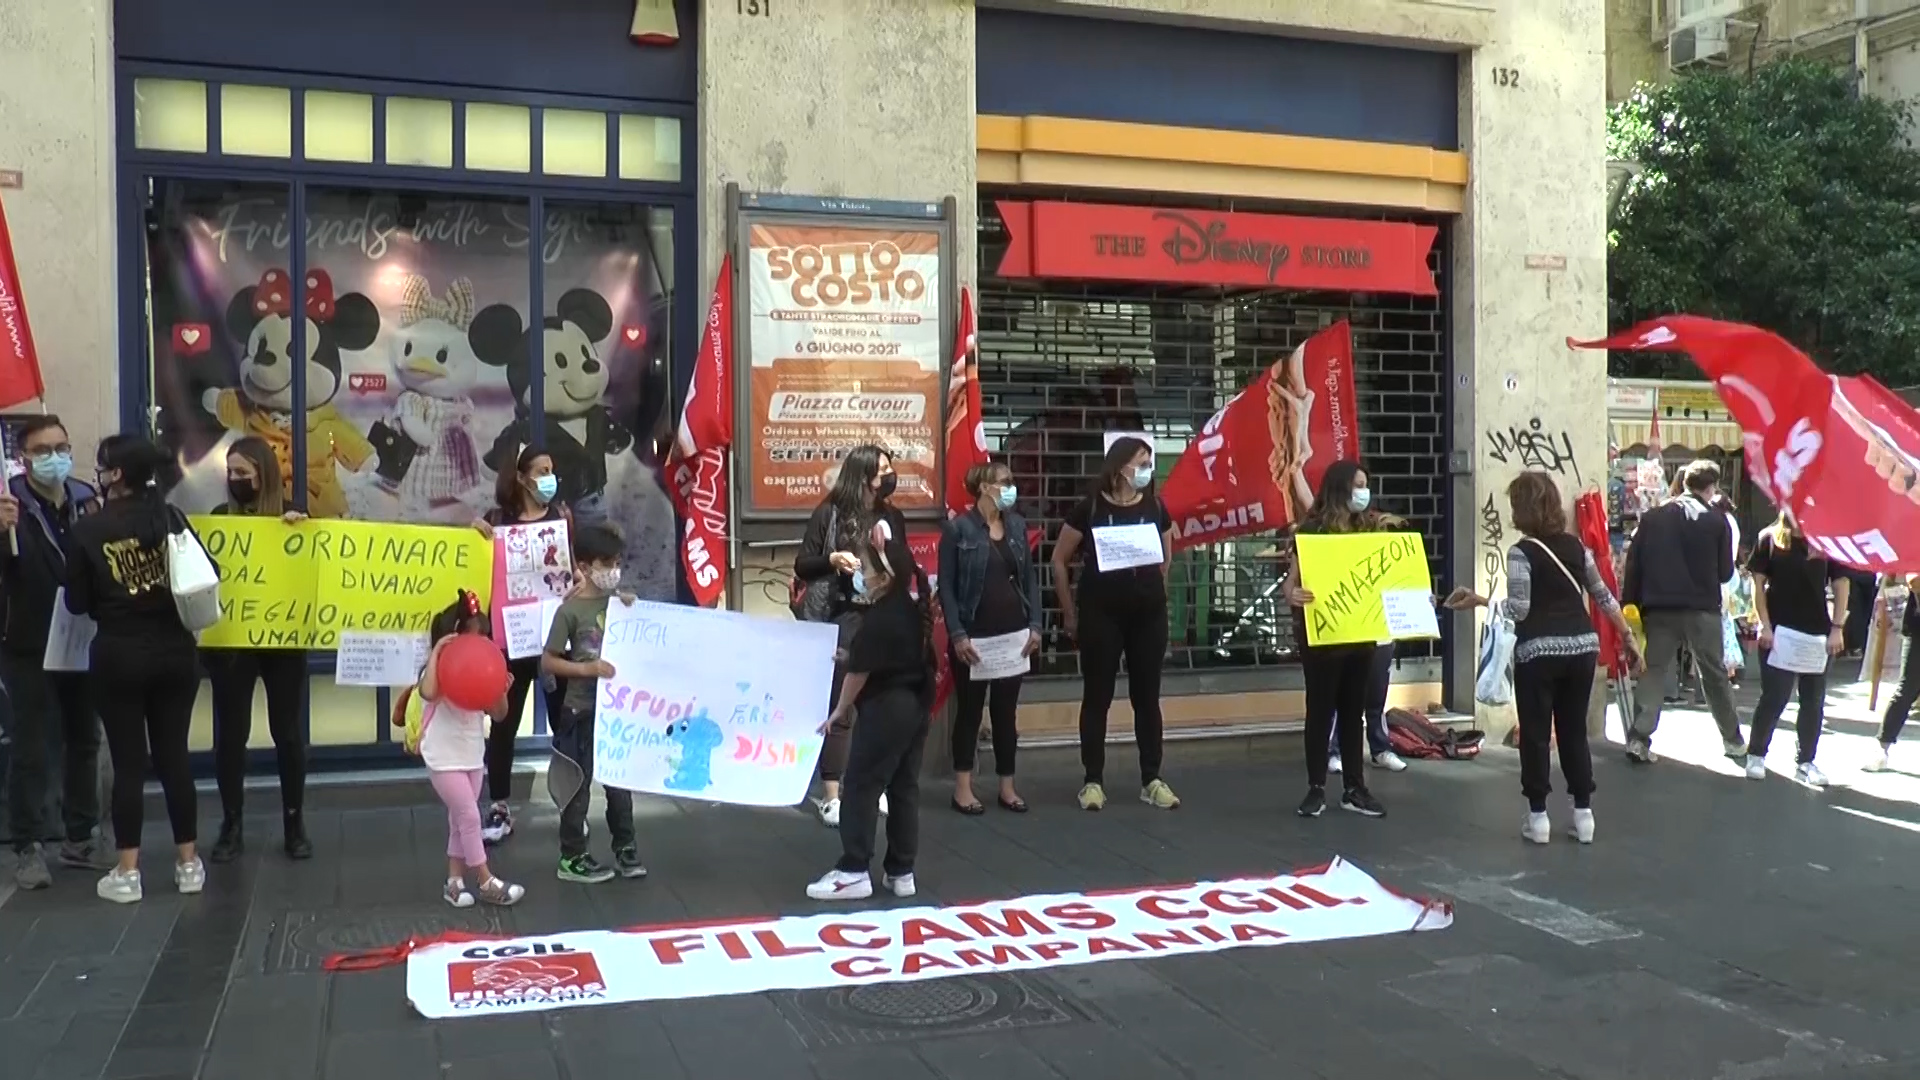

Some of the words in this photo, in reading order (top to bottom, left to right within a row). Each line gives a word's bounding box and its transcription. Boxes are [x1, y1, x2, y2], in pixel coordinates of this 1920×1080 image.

[1491, 66, 1520, 88] 132
[767, 241, 901, 281] SOTTO
[1092, 233, 1146, 258] THE
[1302, 245, 1373, 270] STORE
[791, 270, 925, 307] COSTO
[794, 341, 803, 353] 6
[807, 342, 865, 354] GIUGNO
[782, 393, 843, 409] Piazza
[847, 394, 914, 411] Cavour
[763, 474, 821, 486] expert
[786, 485, 821, 495] NAPOLI
[197, 529, 253, 557] ON
[284, 529, 470, 569] ORDINARE
[341, 568, 433, 595] DIVANO
[1313, 534, 1416, 640] AMMAZZON
[341, 612, 355, 627] IL
[361, 610, 432, 630] CONTA
[248, 629, 336, 646] UMANO
[649, 902, 1116, 965] FILCAMS
[831, 923, 1290, 977] CAMPANIA
